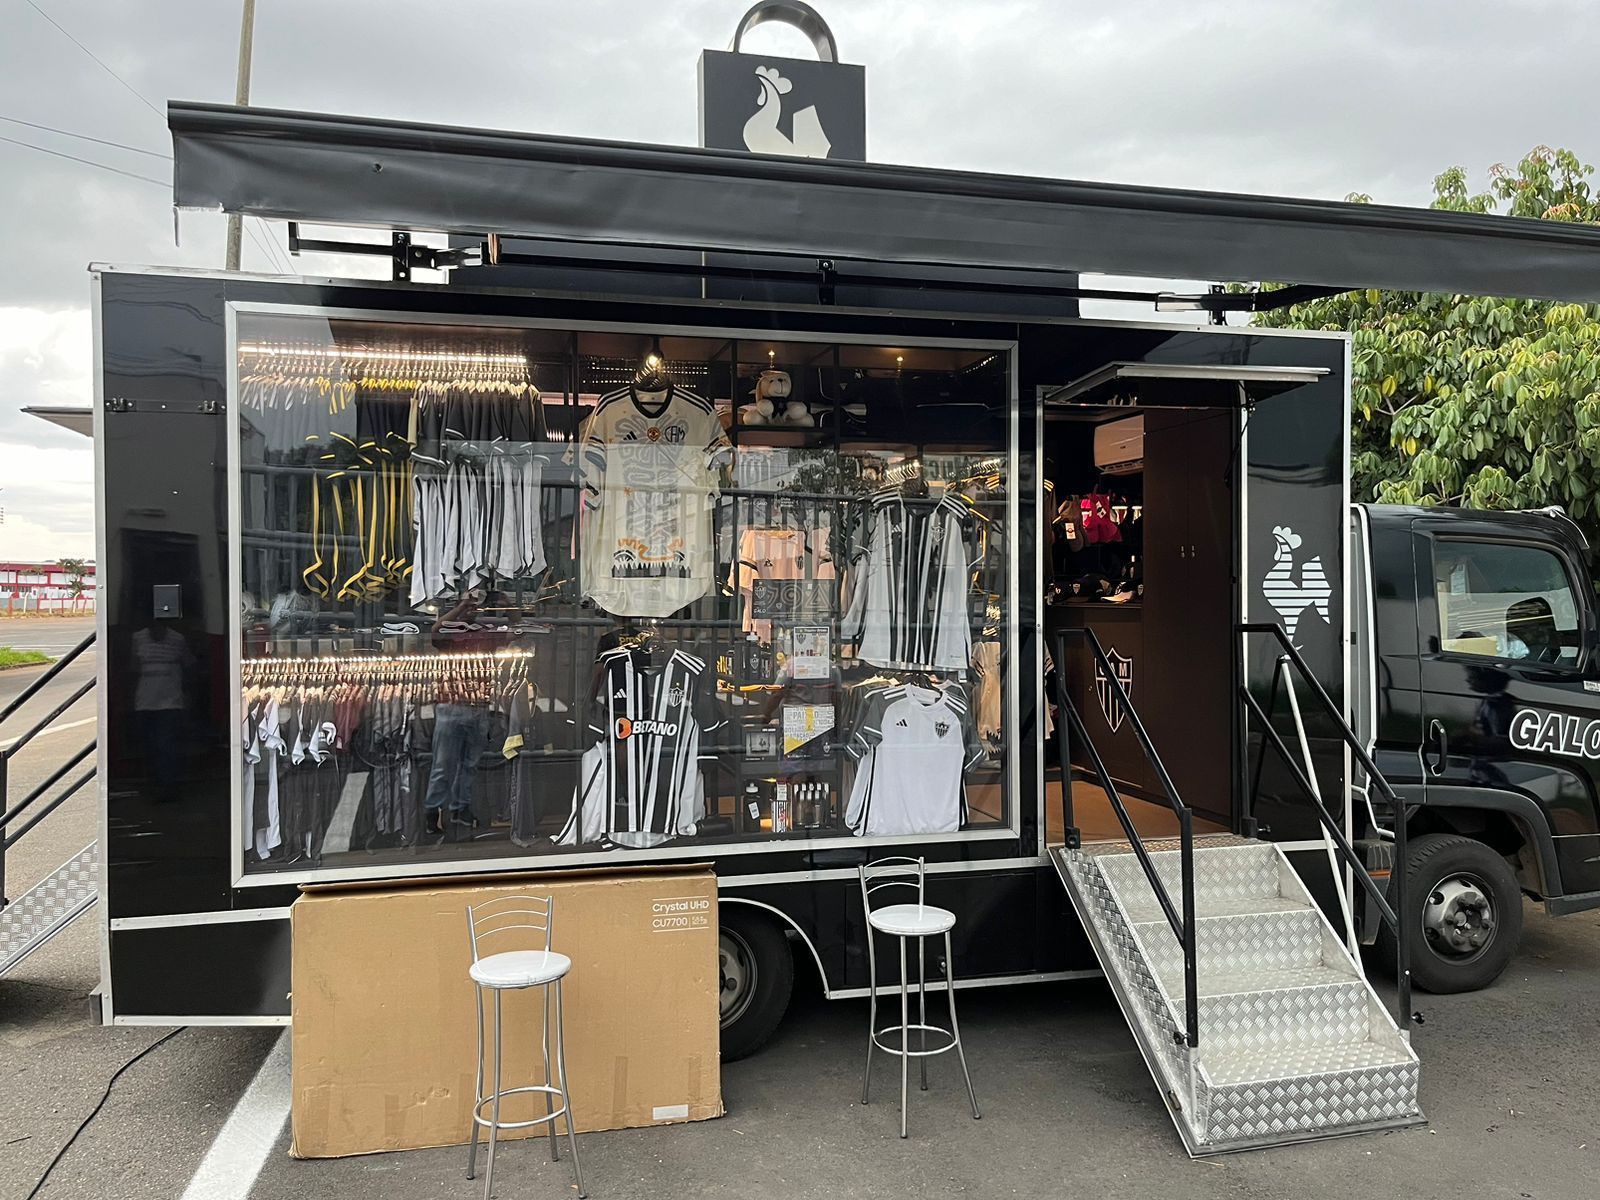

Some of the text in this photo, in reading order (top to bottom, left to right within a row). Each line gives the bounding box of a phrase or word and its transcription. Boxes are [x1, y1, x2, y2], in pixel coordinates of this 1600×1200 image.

[1509, 709, 1600, 759] GALO
[652, 900, 709, 914] Crystal UHD
[652, 917, 687, 928] CU7700
